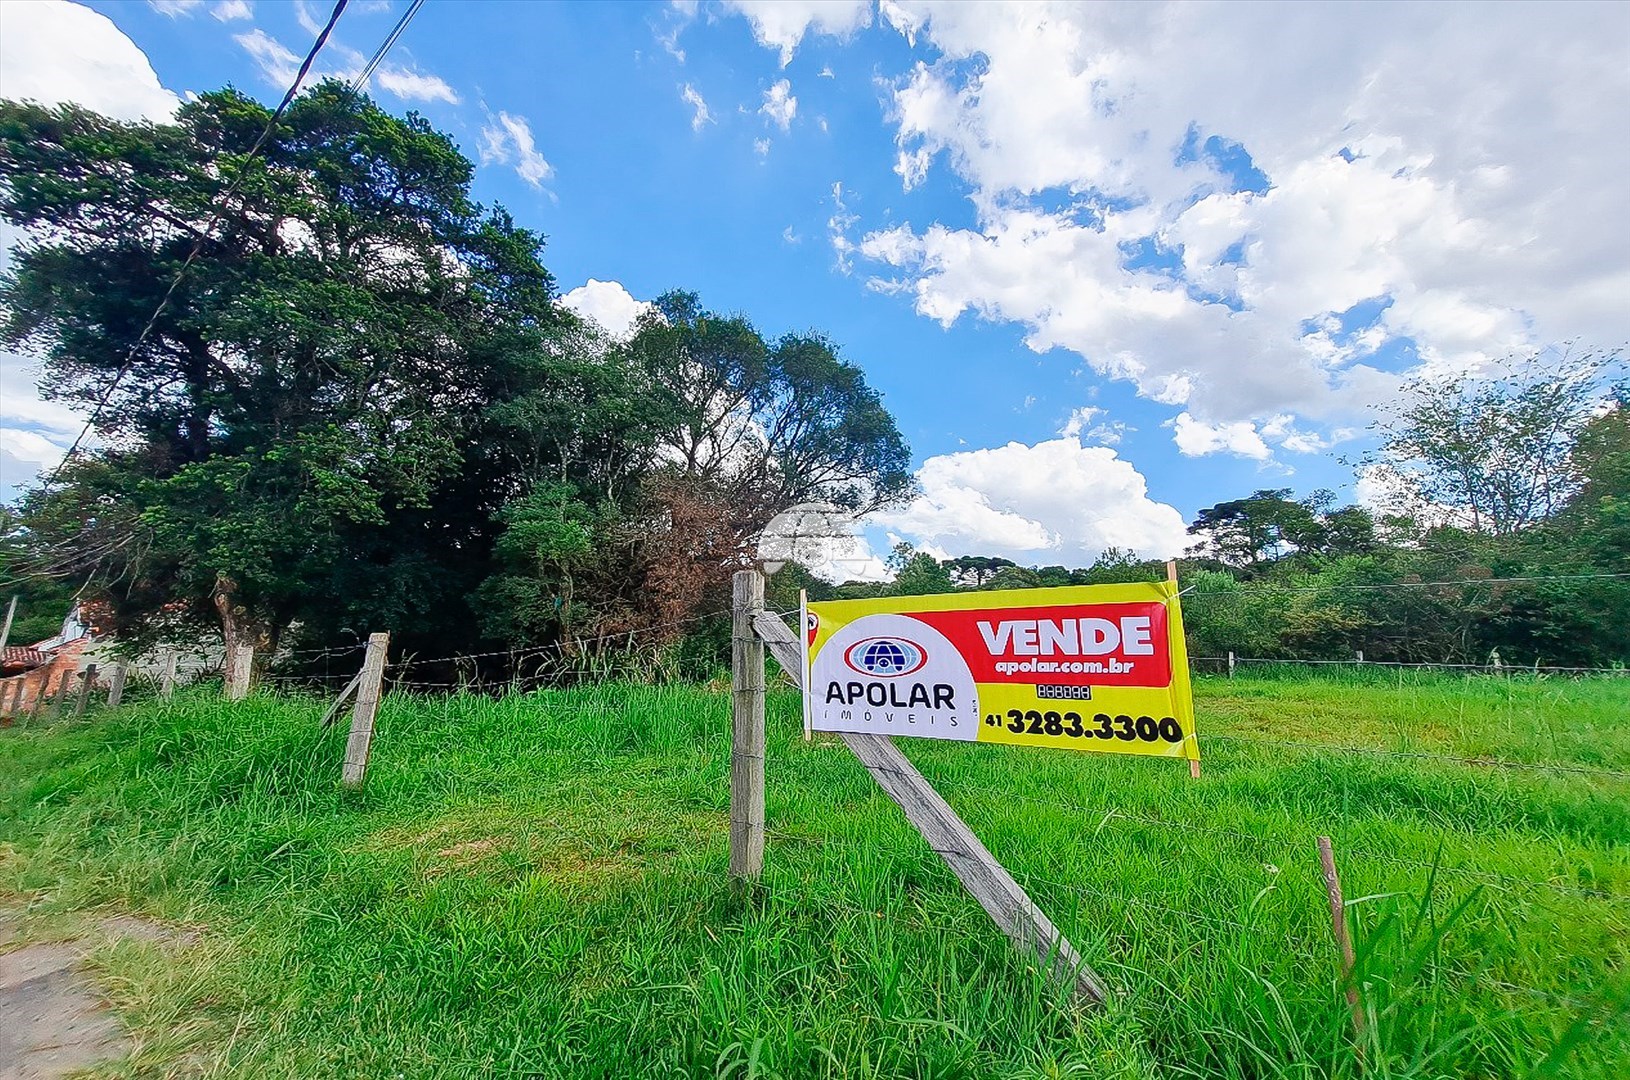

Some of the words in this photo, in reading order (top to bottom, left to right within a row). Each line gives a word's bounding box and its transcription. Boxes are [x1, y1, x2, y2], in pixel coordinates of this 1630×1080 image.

[976, 616, 1154, 655] VENDE
[995, 658, 1134, 675] apolar.com.br
[825, 681, 956, 710] APOLAR
[985, 714, 1002, 727] 41
[1007, 709, 1183, 743] 3283.3300
